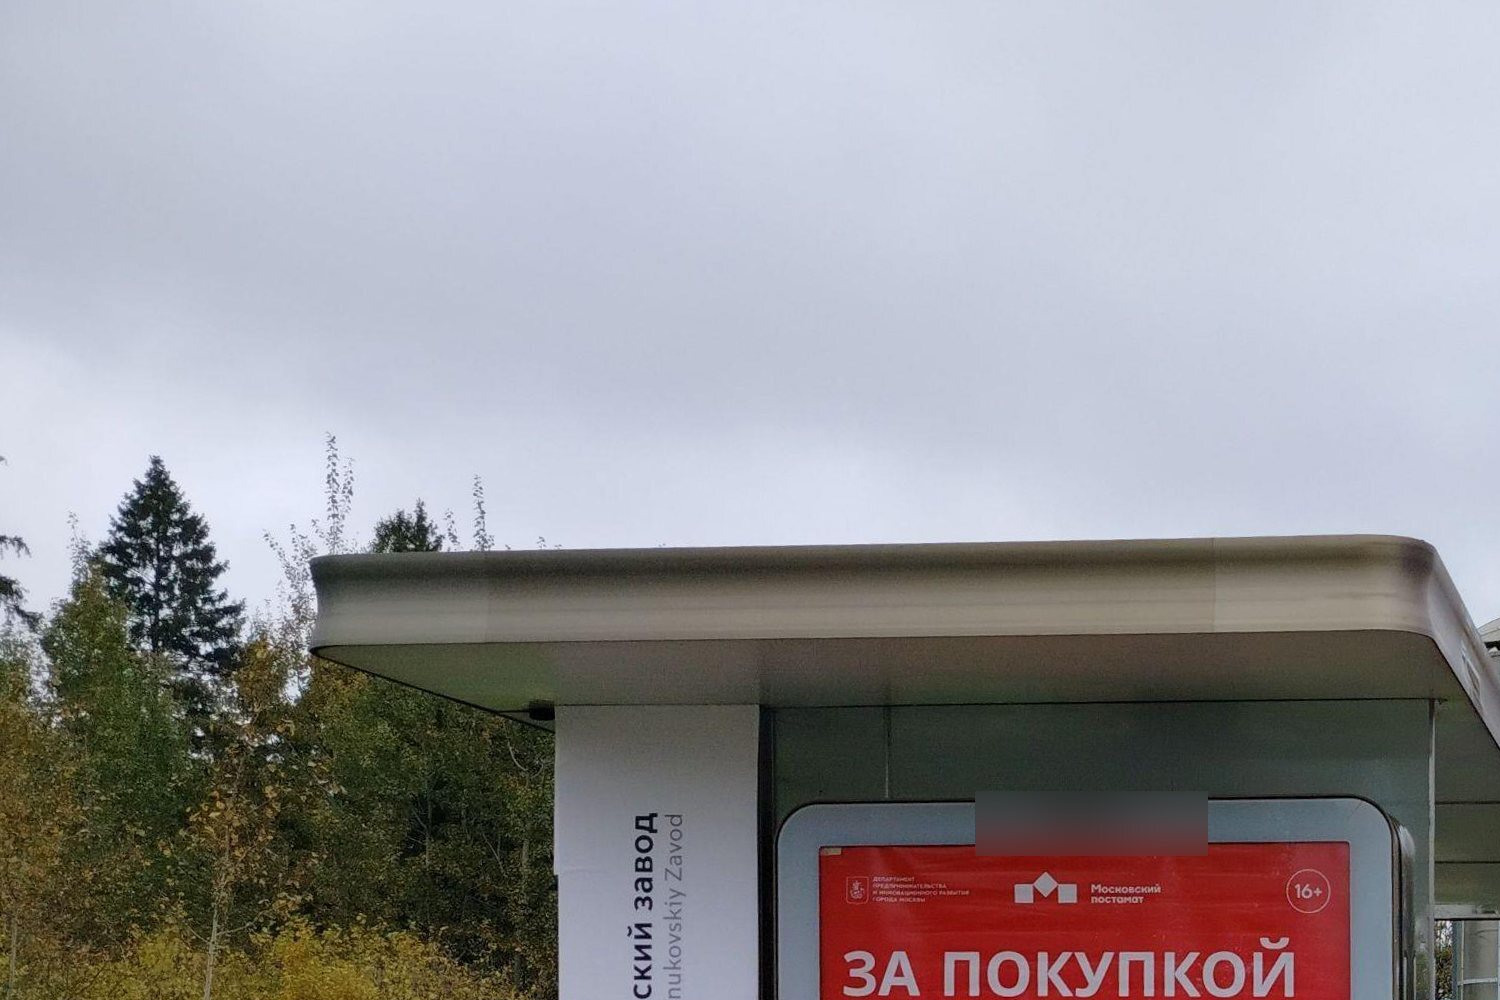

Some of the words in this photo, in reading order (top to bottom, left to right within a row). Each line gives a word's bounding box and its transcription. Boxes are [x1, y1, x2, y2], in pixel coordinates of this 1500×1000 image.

[634, 812, 658, 911] завод
[664, 813, 683, 882] Zavod
[1090, 883, 1162, 894] Московский
[1090, 896, 1145, 904] постамат
[1294, 883, 1323, 899] 16+
[842, 950, 921, 998] ЗА
[943, 936, 1296, 999] ПОКУПКОЙ
